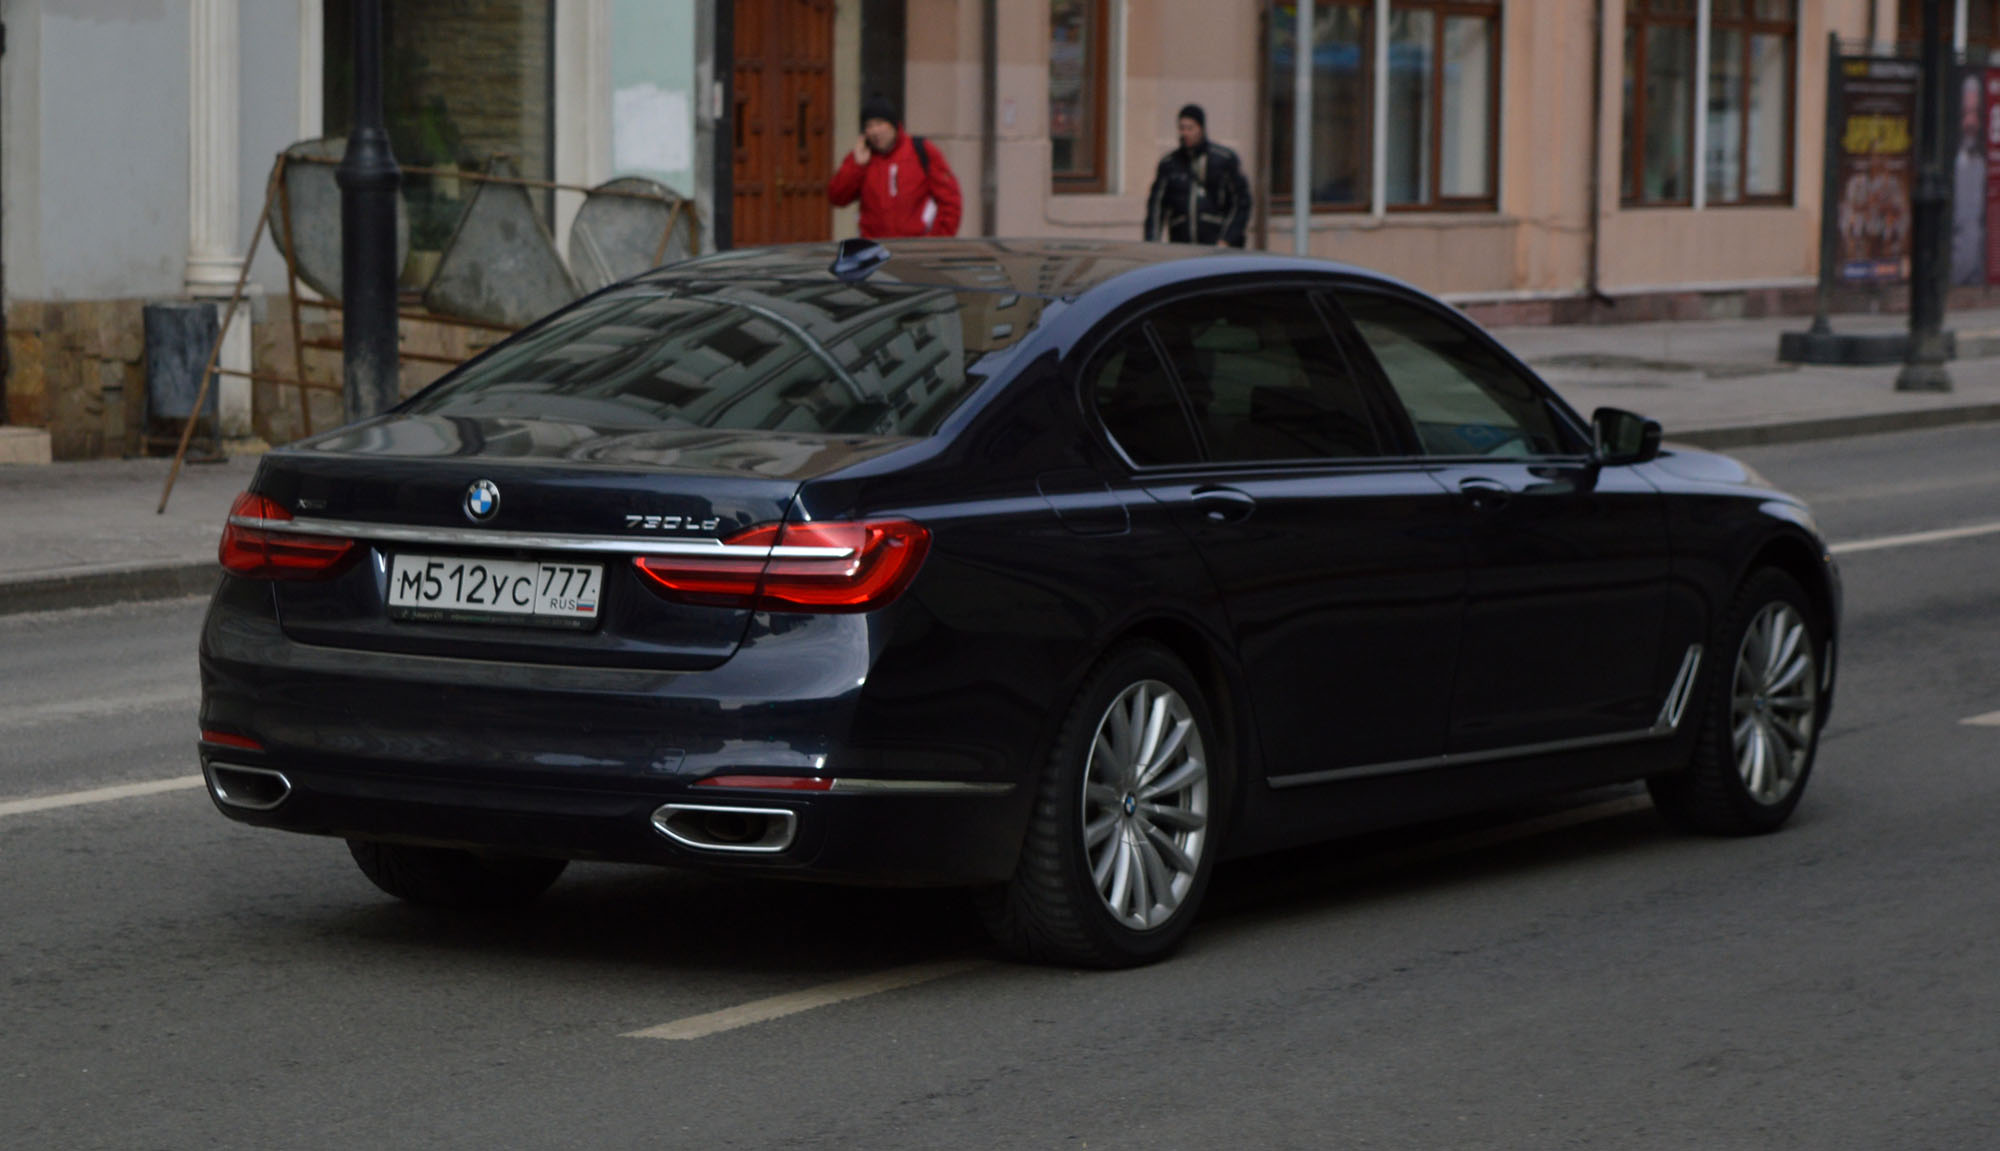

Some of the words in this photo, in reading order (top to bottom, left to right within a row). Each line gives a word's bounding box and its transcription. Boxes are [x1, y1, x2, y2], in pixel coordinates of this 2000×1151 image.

[626, 515, 720, 530] 730Ld
[542, 565, 592, 599] 777
[550, 599, 576, 610] RUS
